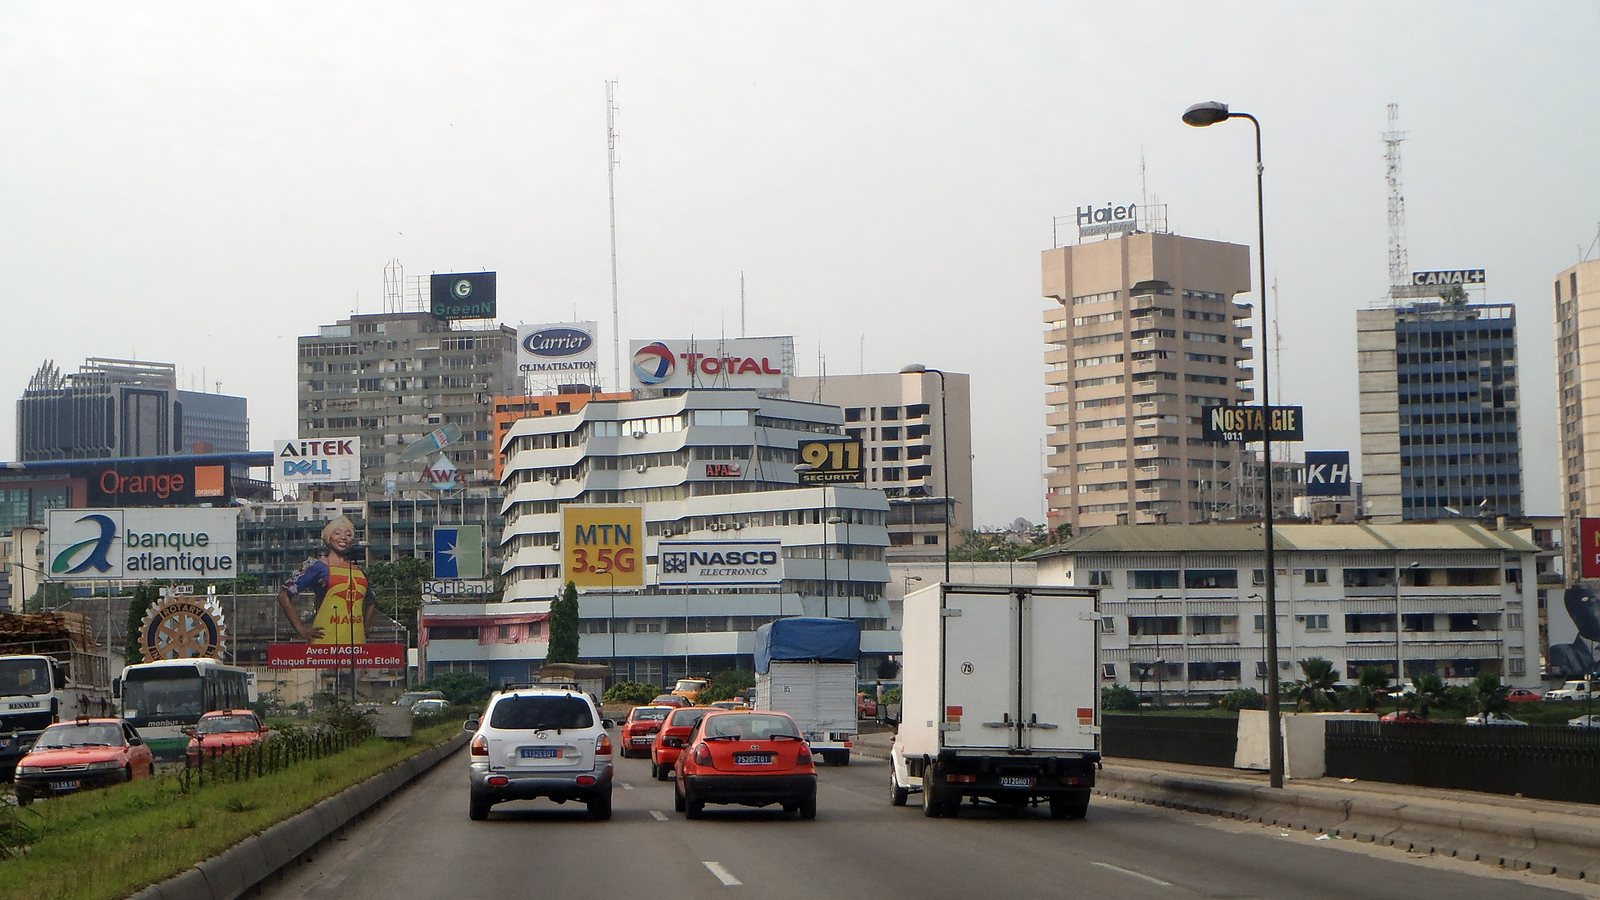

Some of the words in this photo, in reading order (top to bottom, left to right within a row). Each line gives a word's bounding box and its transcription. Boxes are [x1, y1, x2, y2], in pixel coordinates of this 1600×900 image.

[1076, 202, 1137, 226] Haier
[1414, 269, 1484, 286] CANAL+
[528, 333, 586, 351] Carrier
[519, 361, 597, 372] CLIMATISATION
[680, 353, 782, 375] TOTAL
[1211, 406, 1295, 431] NOSTAGIE
[1223, 432, 1243, 440] 101.1
[802, 442, 860, 469] 911
[284, 459, 331, 476] DELL
[100, 469, 185, 498] Orange
[803, 473, 860, 481] SECURITY
[197, 488, 221, 496] orange
[127, 529, 209, 551] banque
[575, 524, 631, 545] MTN
[127, 552, 233, 575] atlantique
[572, 548, 635, 573] 3.5G
[689, 551, 777, 566] NASCO
[700, 568, 767, 576] ELECTRONICS
[423, 581, 493, 594] BGFIBank
[163, 604, 201, 616] ROTARY
[306, 646, 329, 655] Avec
[271, 658, 305, 667] chaque
[375, 656, 400, 665] Etoile
[8, 701, 40, 709] RENAULT
